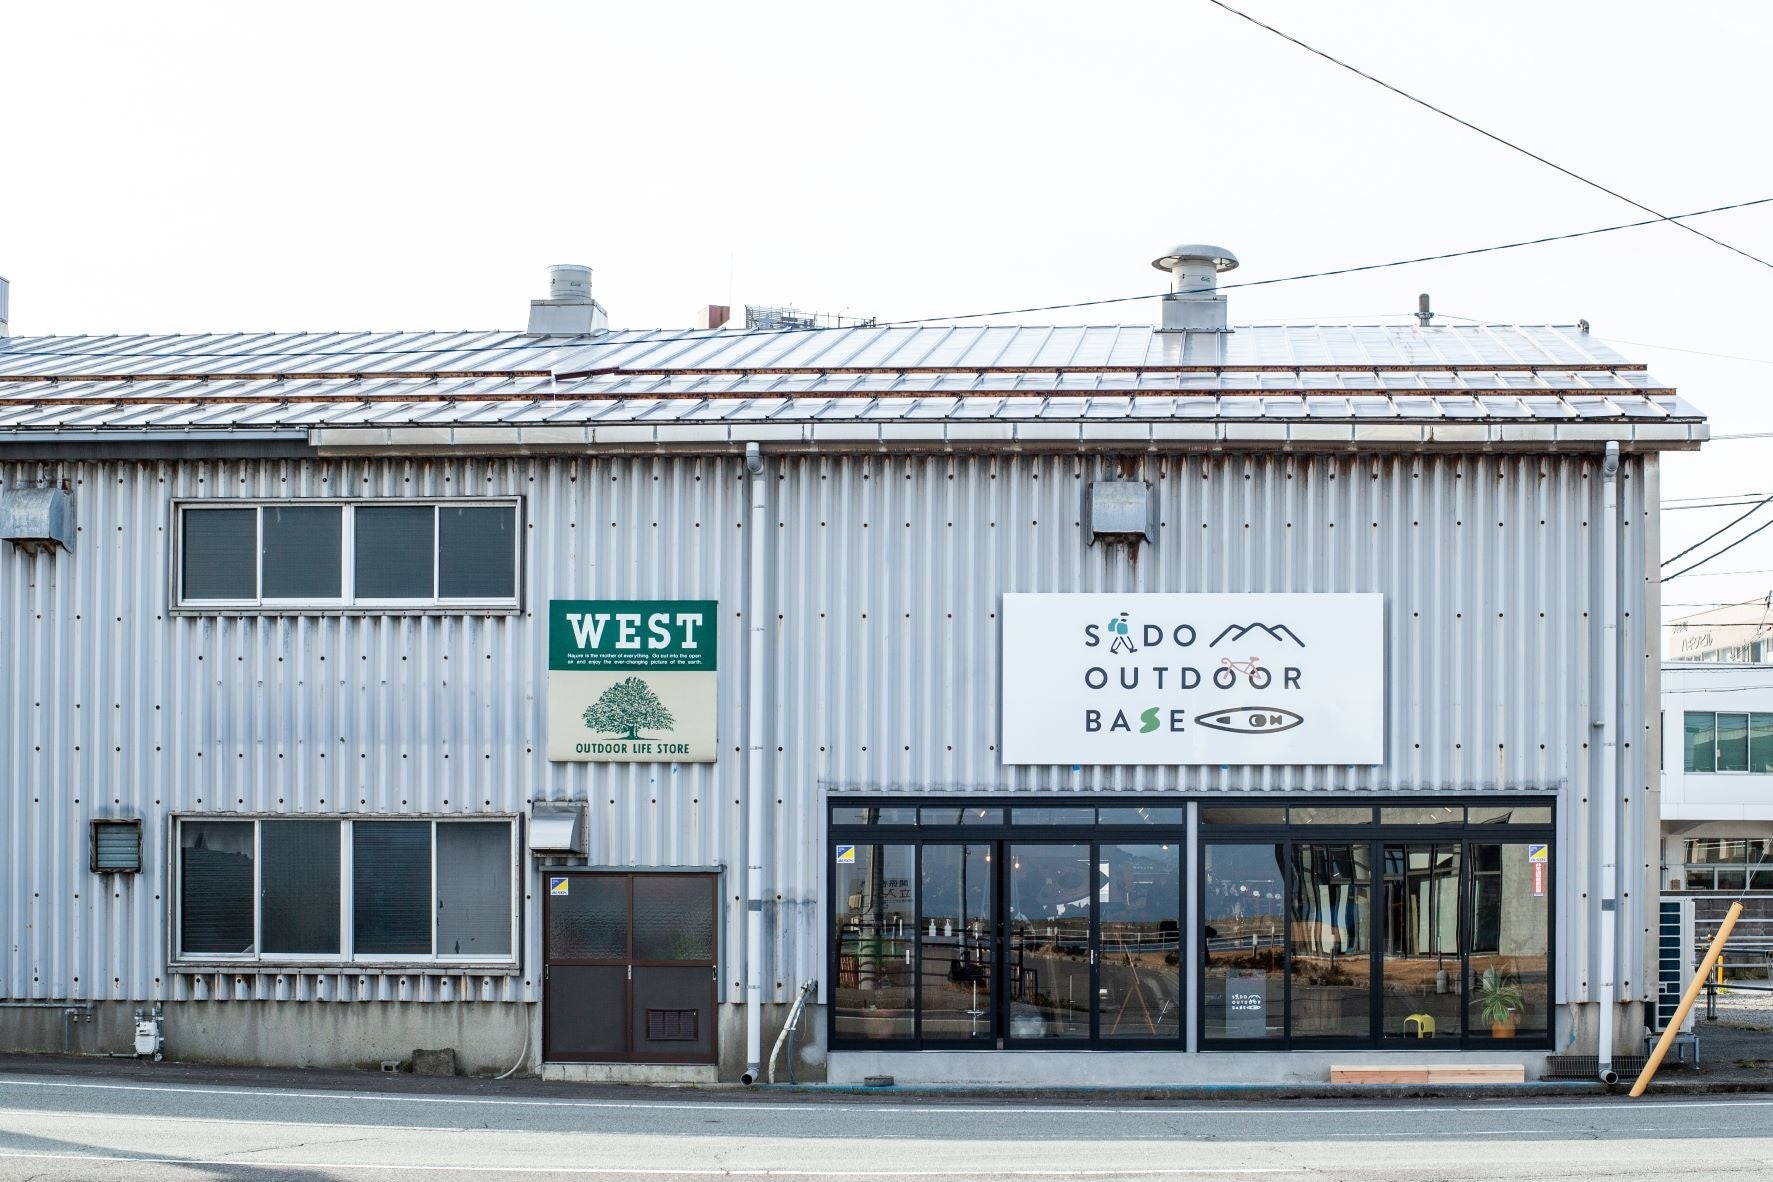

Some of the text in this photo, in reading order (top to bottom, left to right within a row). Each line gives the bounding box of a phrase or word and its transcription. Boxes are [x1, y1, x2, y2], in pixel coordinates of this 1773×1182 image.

[566, 613, 703, 649] WEST
[1085, 663, 1302, 690] OUTDOOR
[1085, 707, 1185, 733] BASE
[576, 743, 690, 754] OUTDOOR LIFE STORE
